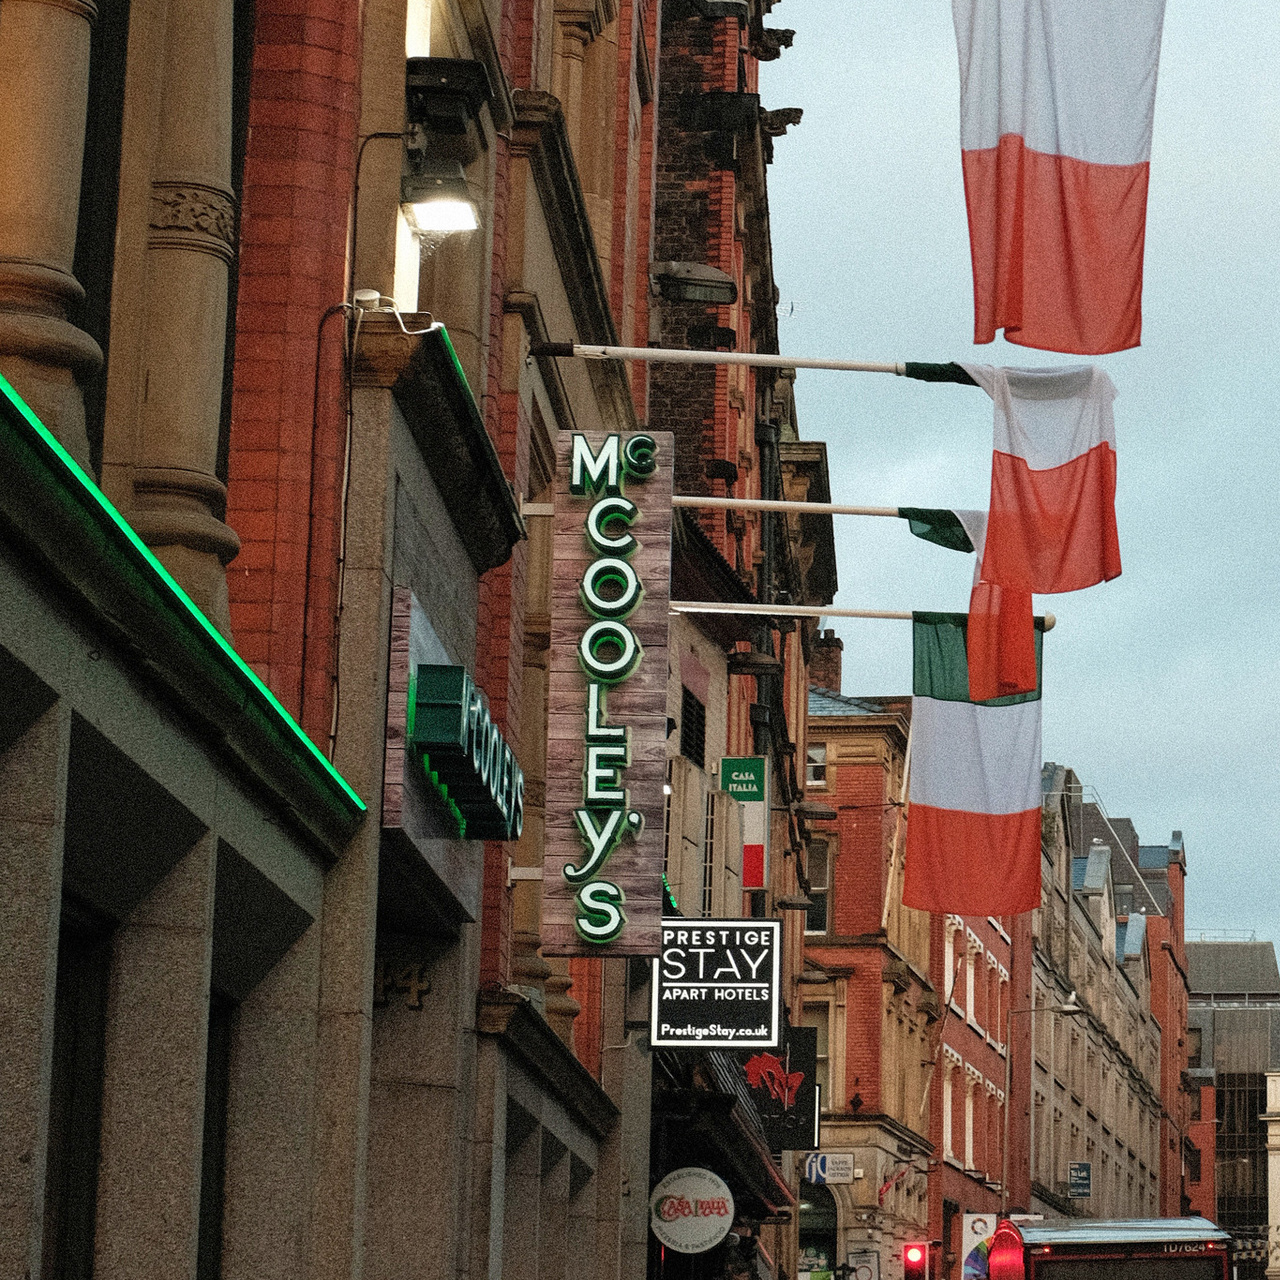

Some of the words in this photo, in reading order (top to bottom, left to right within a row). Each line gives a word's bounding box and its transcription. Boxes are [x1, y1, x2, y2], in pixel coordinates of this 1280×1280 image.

[731, 771, 755, 780] CASA
[728, 783, 758, 792] ITALIA
[663, 930, 770, 945] PRESTIGE
[663, 948, 769, 979] STAY
[662, 988, 708, 1000] APART
[714, 988, 769, 1001] HOTELS
[661, 1023, 768, 1040] PrestigeStay.co.uk
